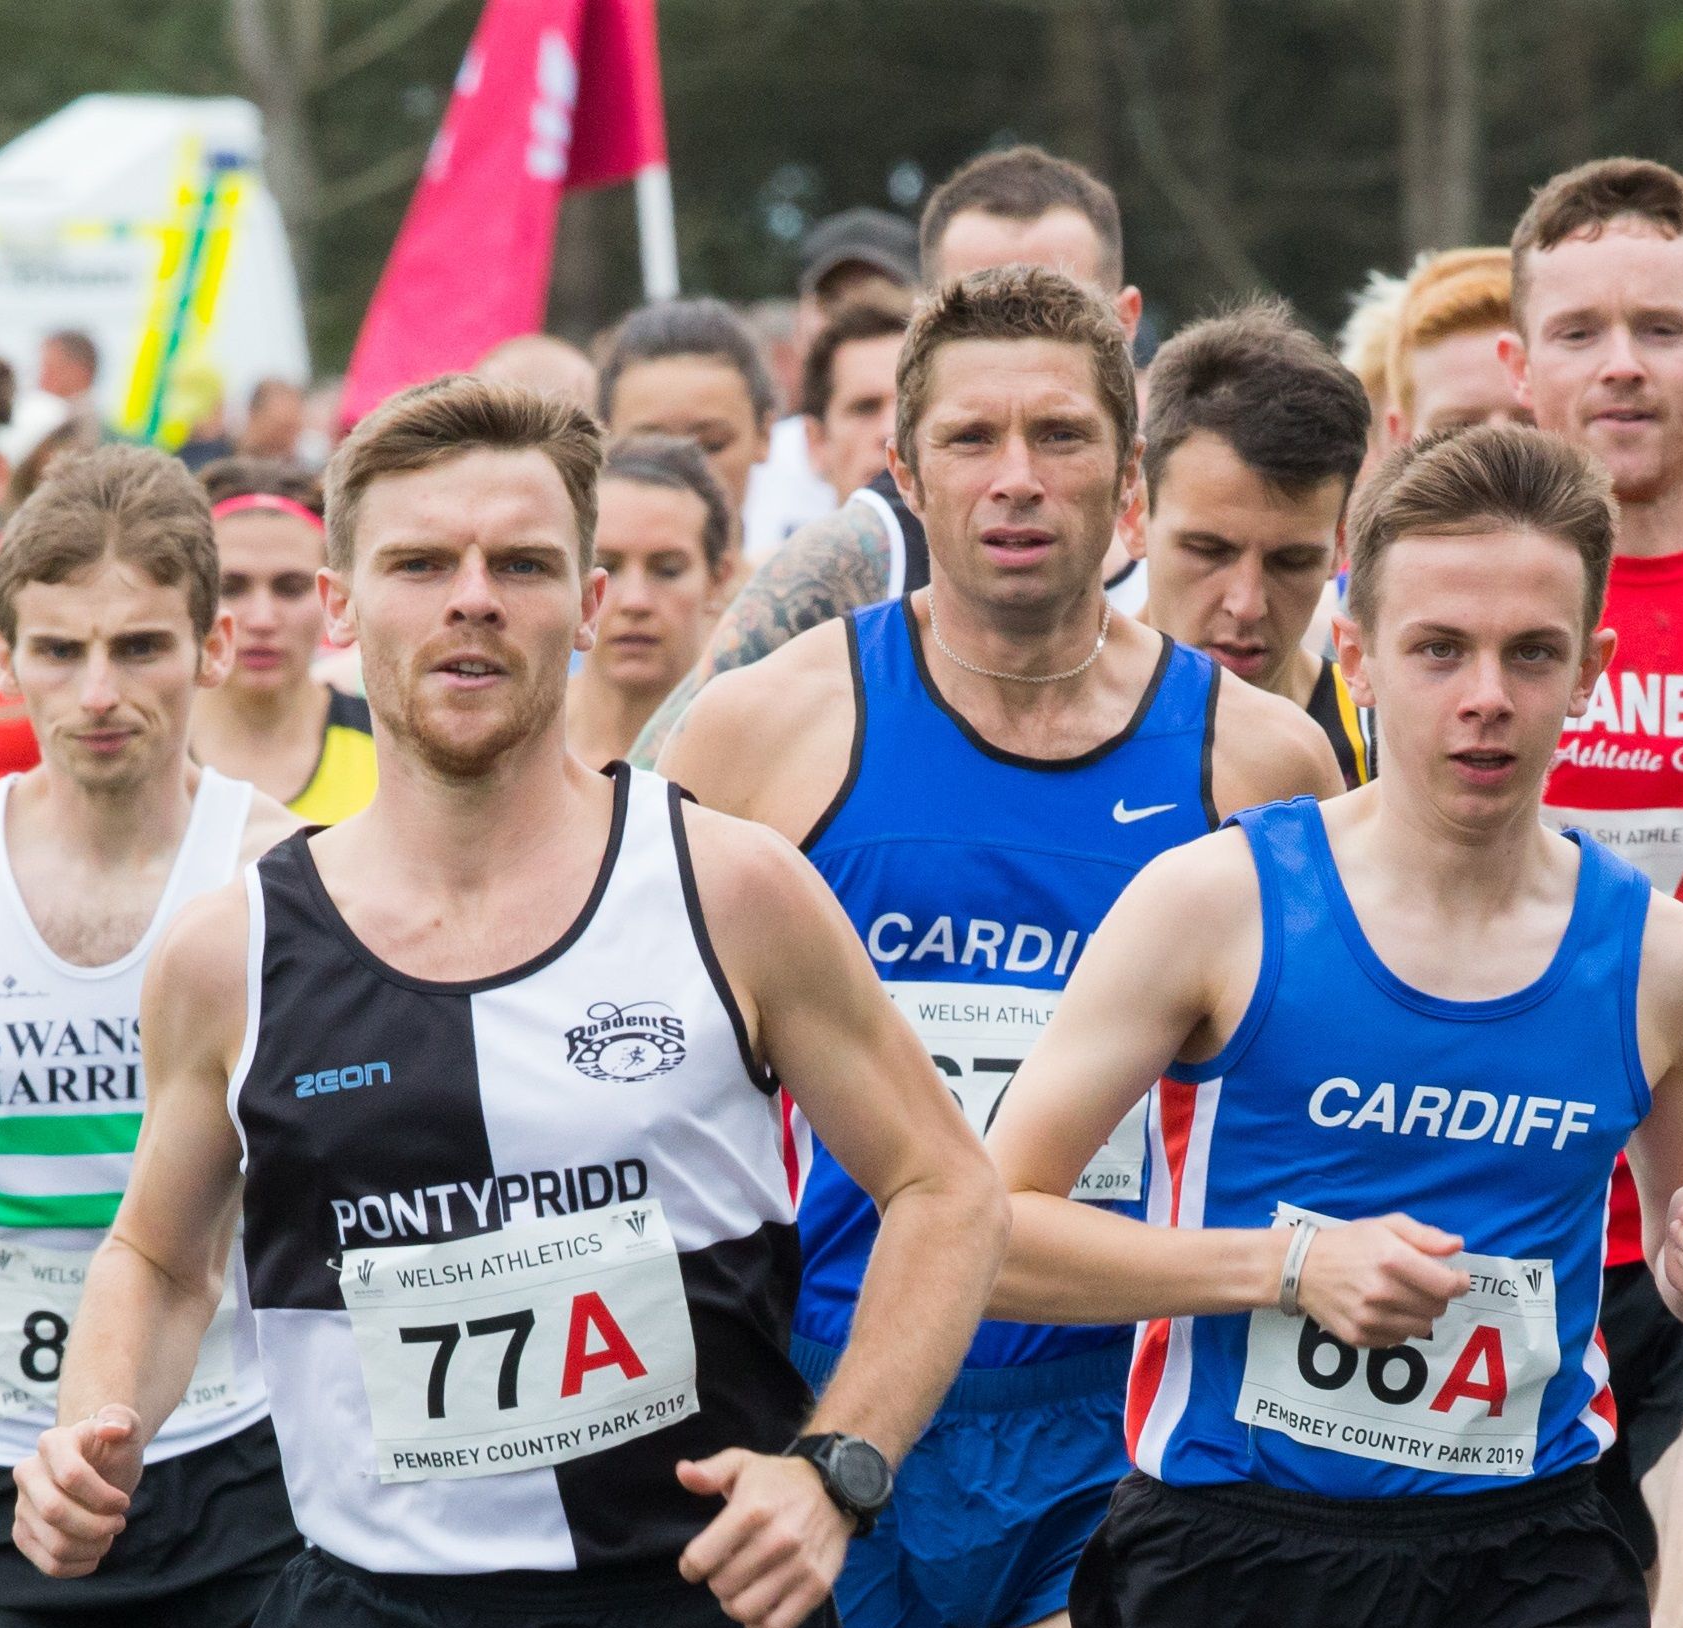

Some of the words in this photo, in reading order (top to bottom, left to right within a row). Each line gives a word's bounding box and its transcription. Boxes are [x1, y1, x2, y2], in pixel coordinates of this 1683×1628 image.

[868, 911, 1095, 976] CARDI
[918, 1003, 989, 1023] WELSH
[1308, 1077, 1596, 1151] CARDIFF
[331, 1158, 649, 1245] PONTYPRIDD
[1095, 1174, 1131, 1189] 2019
[397, 1262, 474, 1289] WELSH
[480, 1234, 604, 1280] ATHLETICS
[393, 1447, 480, 1470] PEMBREY
[487, 1429, 583, 1462] COUNTRY
[587, 1408, 641, 1441] PARK
[645, 1394, 686, 1422] 2019
[1256, 1398, 1338, 1439] PEMBREY
[1341, 1426, 1435, 1459] COUNTRY
[1437, 1445, 1482, 1464] PARK
[1486, 1447, 1525, 1465] 2019
